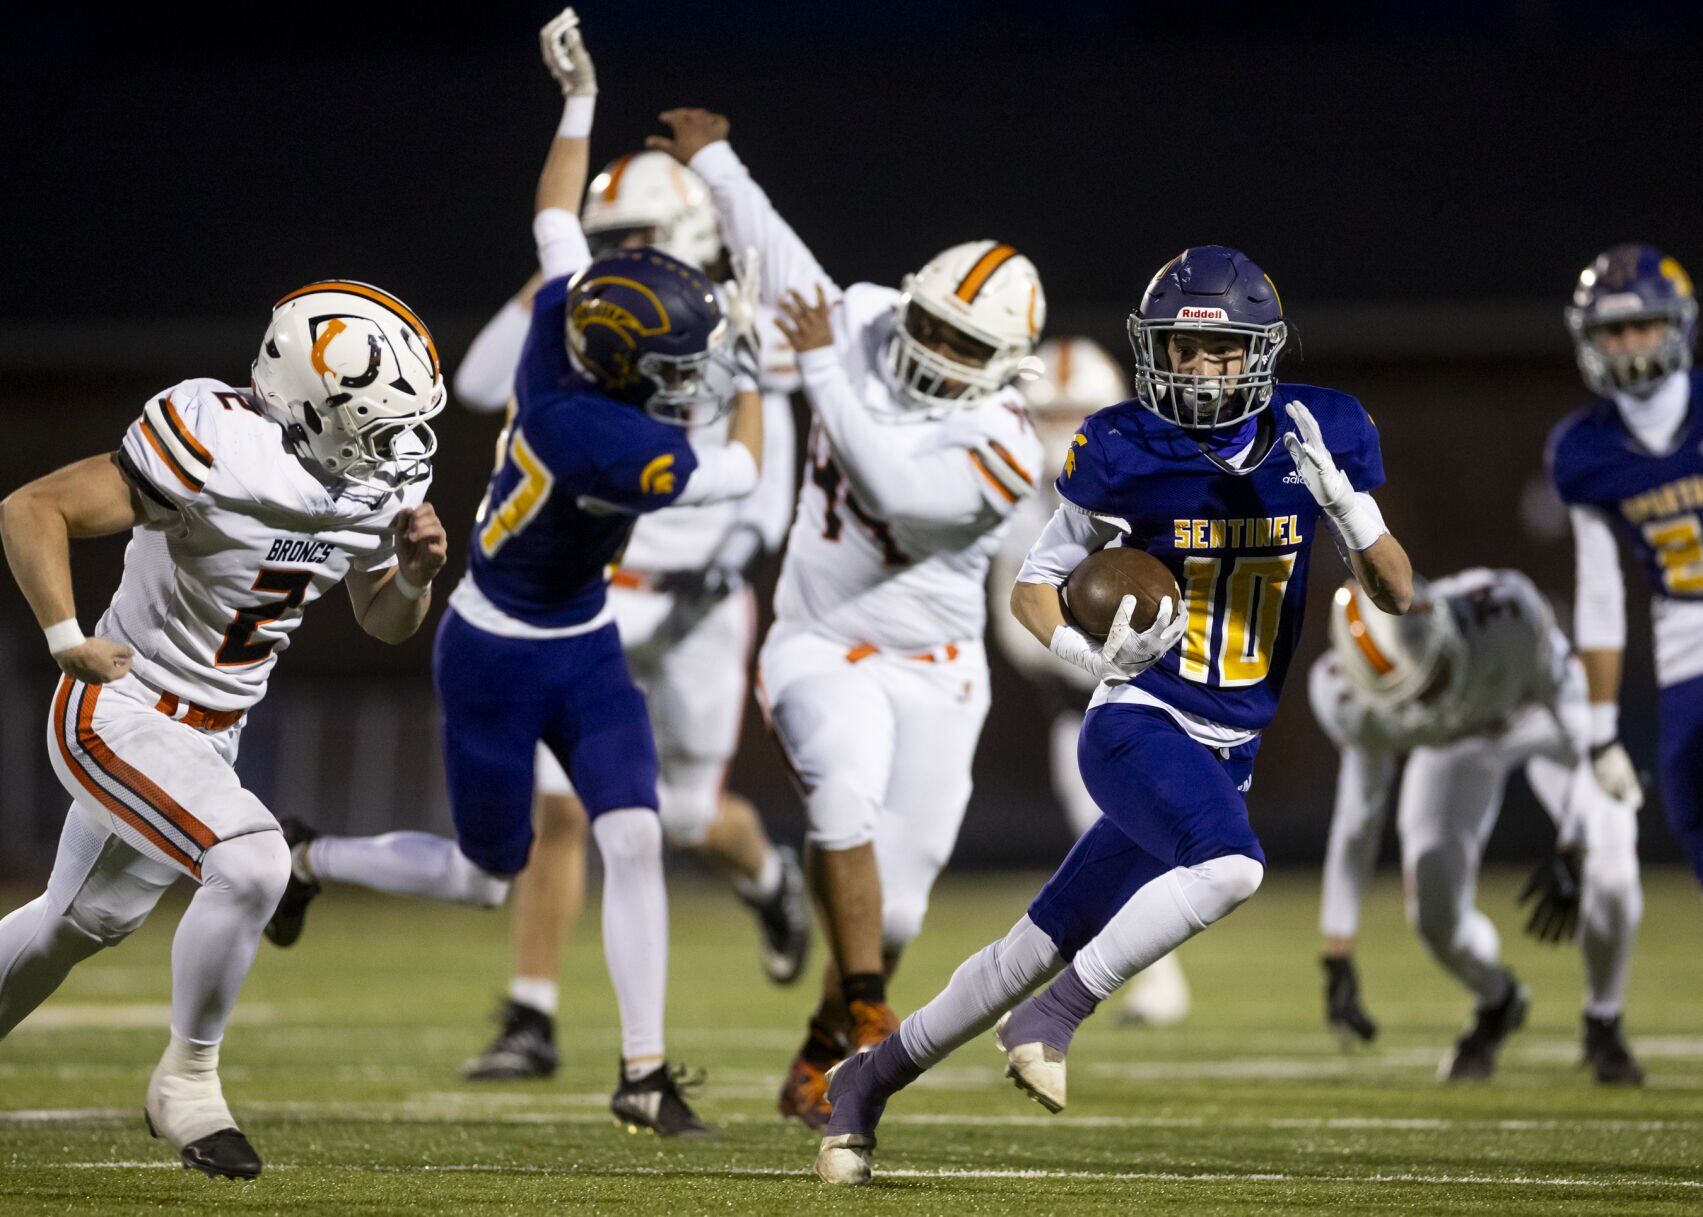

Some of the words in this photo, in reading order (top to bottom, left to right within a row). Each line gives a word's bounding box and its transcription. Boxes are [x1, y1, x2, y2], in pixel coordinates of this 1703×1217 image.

[1182, 309, 1222, 319] Riddell
[478, 428, 555, 559] 7
[265, 538, 336, 564] BRONCS
[1173, 514, 1303, 549] SENTINEL
[214, 568, 315, 667] 2
[1178, 551, 1297, 687] 10
